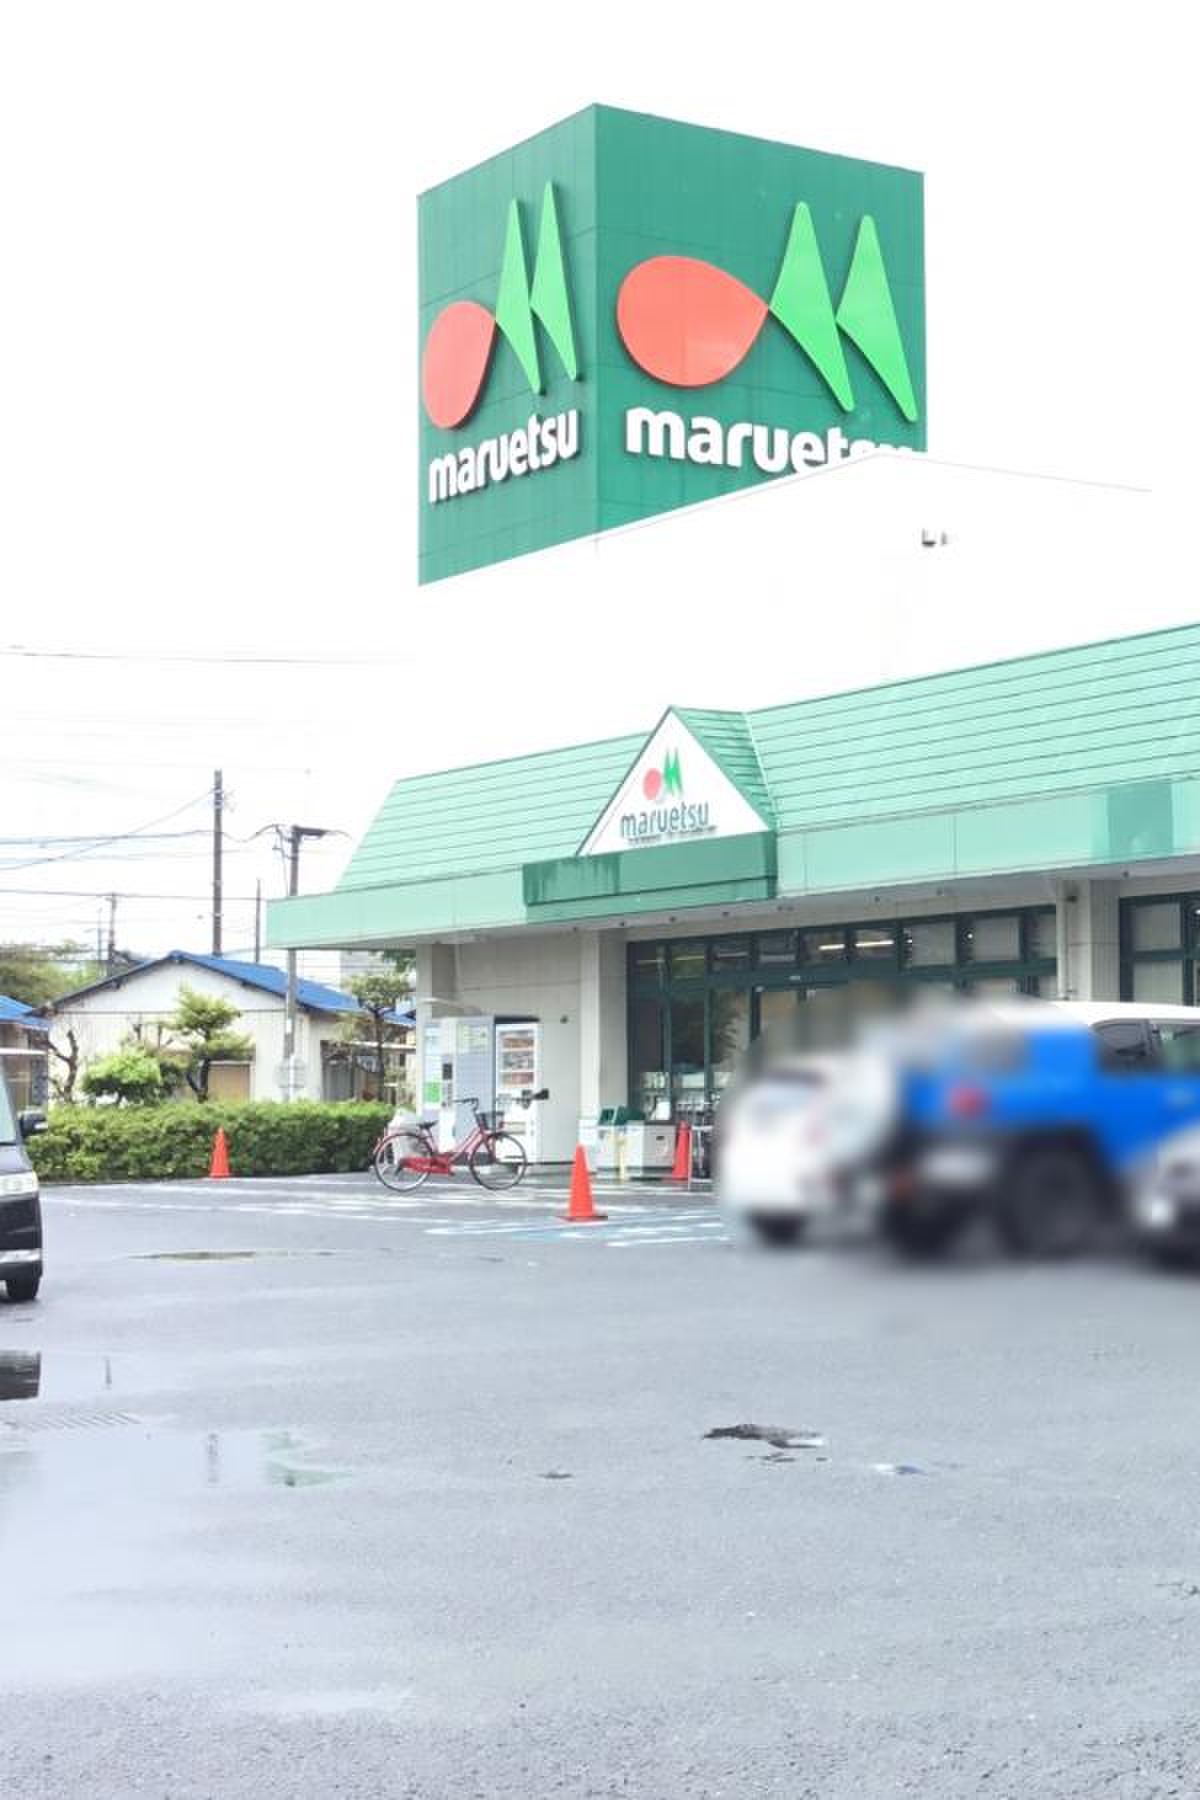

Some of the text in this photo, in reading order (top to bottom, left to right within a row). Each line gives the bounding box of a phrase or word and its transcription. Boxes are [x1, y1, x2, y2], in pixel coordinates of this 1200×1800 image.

[428, 408, 580, 504] maruetsu
[625, 406, 915, 473] maruet
[619, 801, 709, 838] maruetsu
